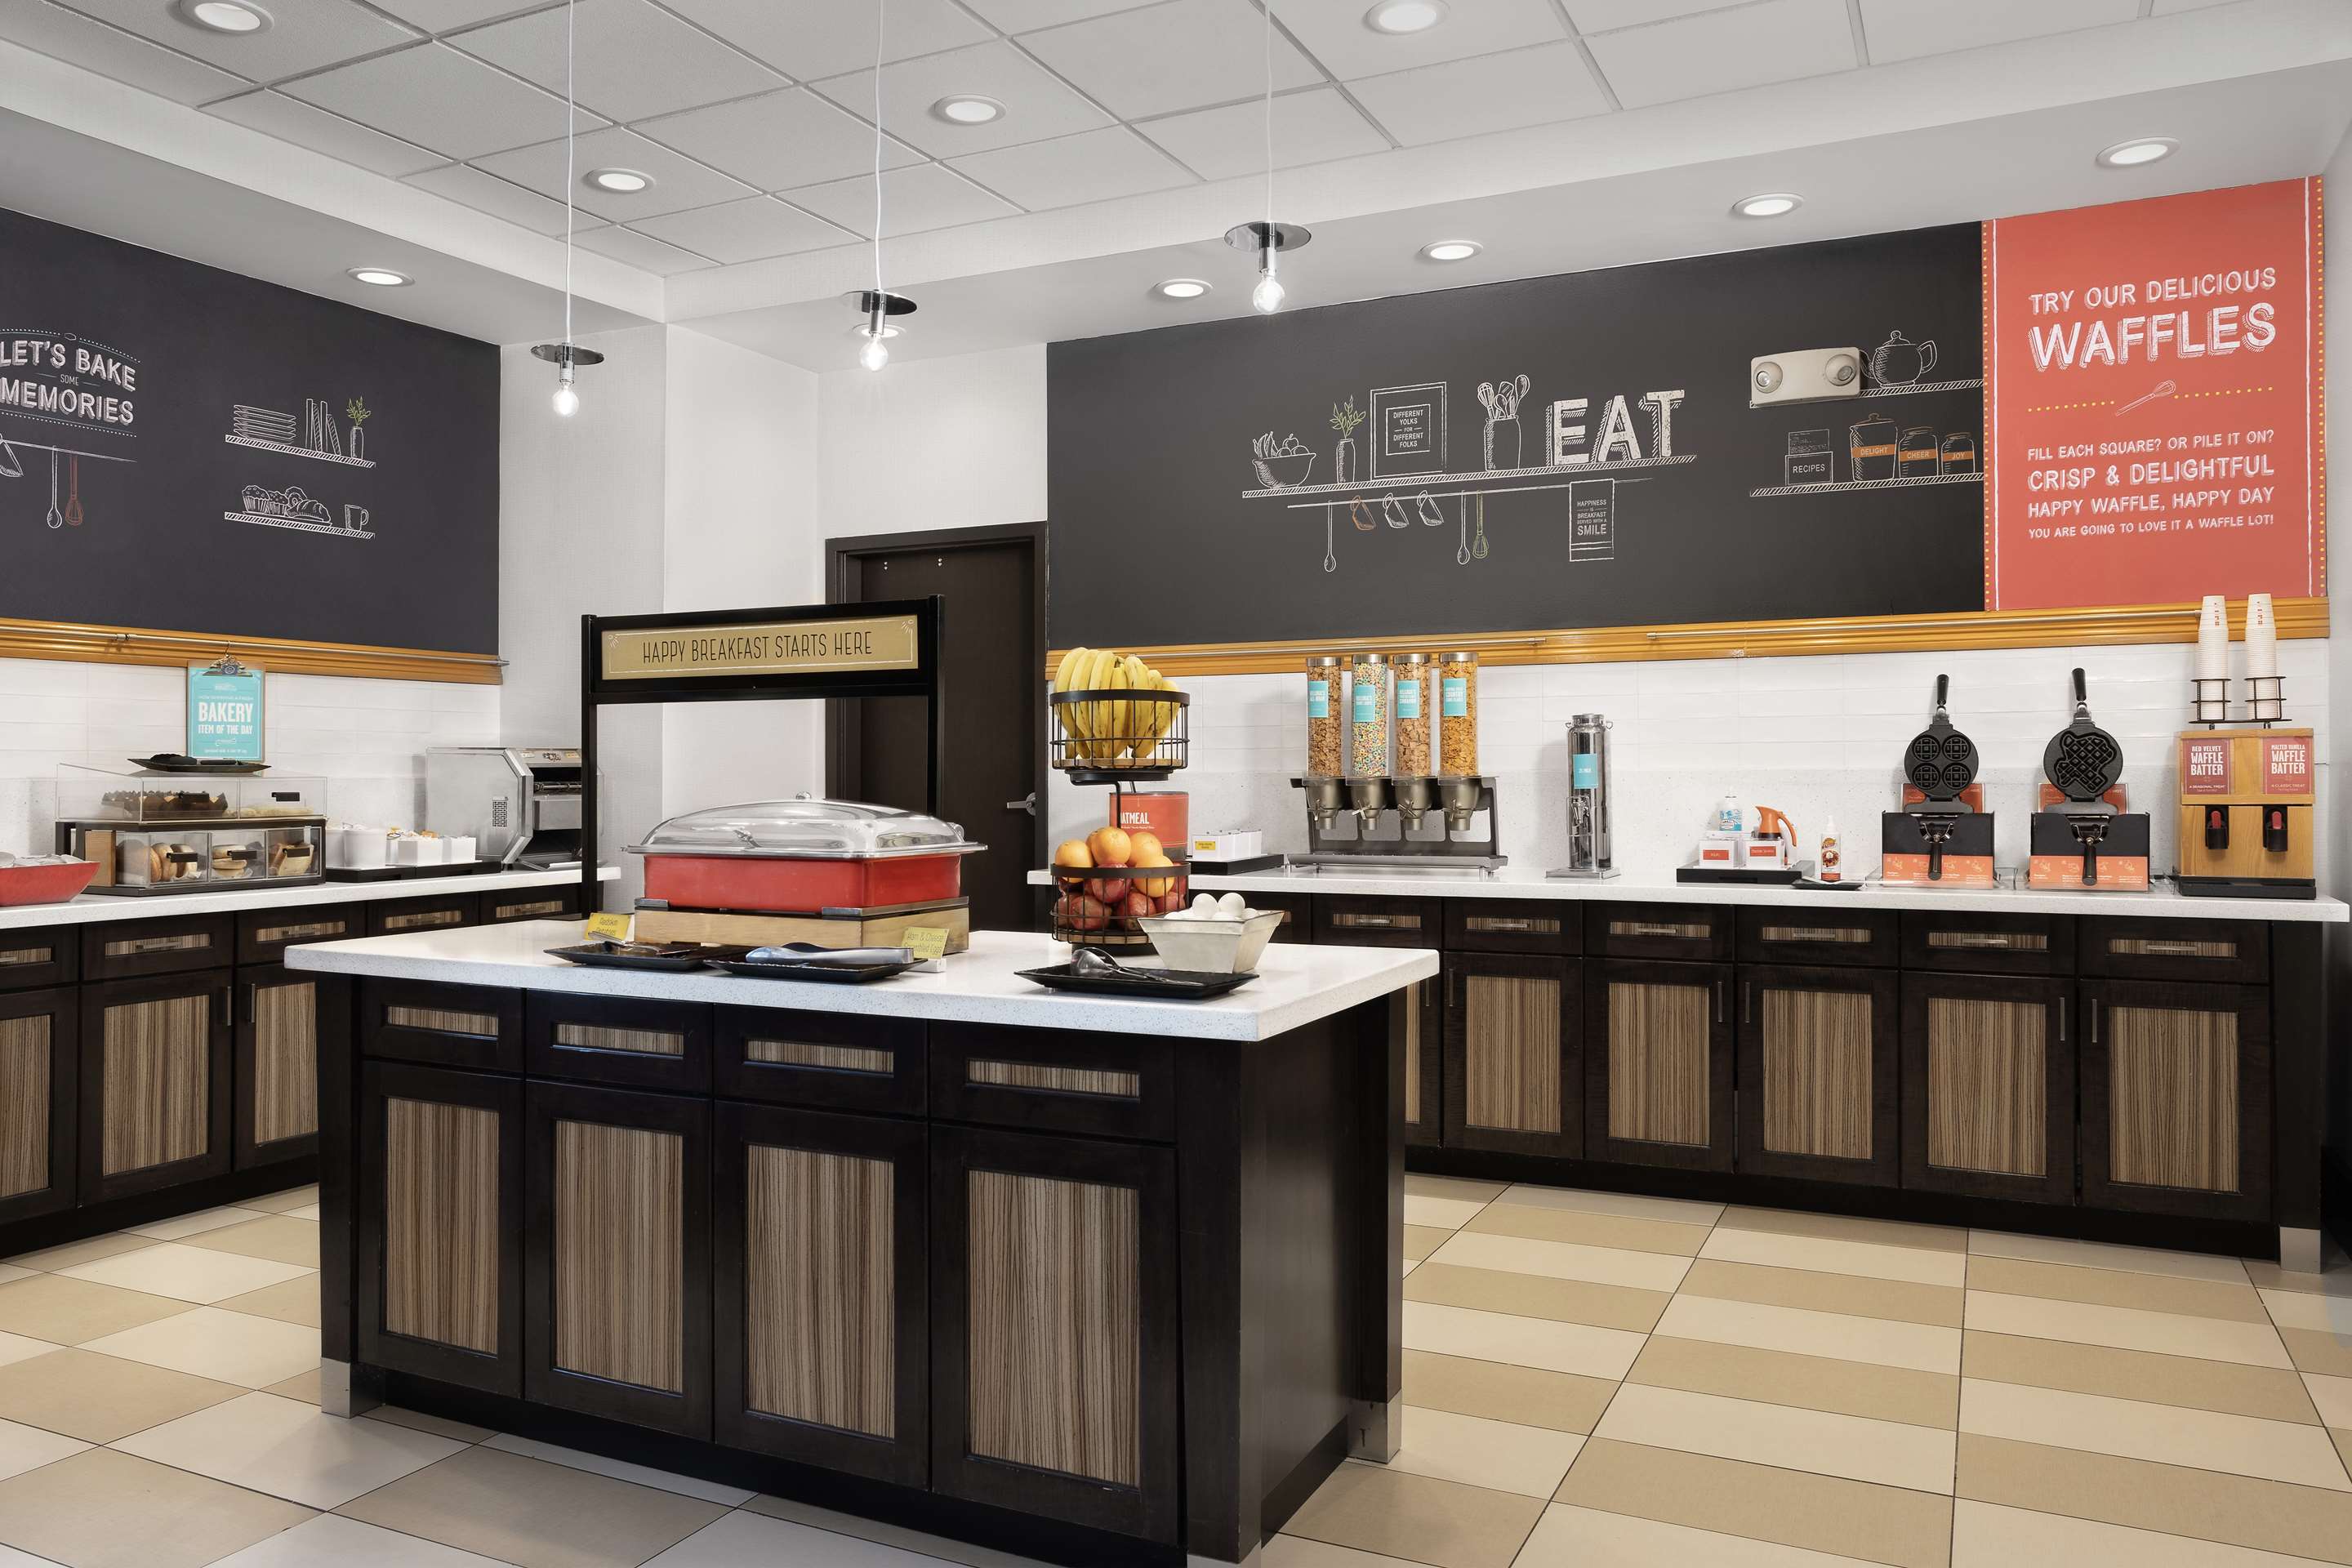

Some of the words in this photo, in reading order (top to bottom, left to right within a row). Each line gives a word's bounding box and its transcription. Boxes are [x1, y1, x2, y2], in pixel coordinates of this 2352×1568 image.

[2029, 291, 2074, 314] TRY
[2084, 284, 2136, 309] OUR
[2146, 267, 2276, 303] DELICIOUS
[2028, 302, 2276, 372] WAFFLES
[0, 340, 66, 368] LET'S
[76, 348, 136, 392] BAKE
[60, 373, 79, 386] SOME
[0, 376, 134, 425] MEMORIES
[1393, 409, 1423, 418] DIFFERENT
[1546, 390, 1685, 466] EAT
[1393, 433, 1423, 441] DIFFERENT
[2028, 448, 2053, 461] FILL
[2058, 444, 2094, 459] EACH
[2099, 439, 2162, 456] SQUARE?
[2167, 437, 2187, 450] OR
[2194, 434, 2222, 448] PILE
[2227, 432, 2240, 446] IT
[2247, 429, 2274, 444] ON?
[1860, 447, 1888, 456] DELIGHT
[1907, 451, 1930, 459] CHEER
[1793, 464, 1825, 474] RECIPES
[2028, 467, 2096, 491] CRISP
[2105, 465, 2119, 486] &
[2130, 454, 2274, 485] DELIGHTFUL
[2028, 499, 2083, 518] HAPPY
[2091, 493, 2165, 514] WAFFLE,
[2172, 489, 2231, 509] HAPPY
[2238, 486, 2274, 505] DAY
[1577, 524, 1607, 536] SMILE
[2029, 528, 2050, 540] YOU
[2054, 526, 2077, 537] ARE
[2081, 523, 2115, 536] GOING
[2119, 523, 2134, 533] TO
[2139, 520, 2167, 532] LOVE
[2171, 519, 2181, 530] IT
[2185, 519, 2194, 529] A
[2198, 516, 2244, 528] WAFFLE
[2248, 514, 2274, 525] LOT!
[644, 640, 686, 663] HAPPY
[692, 636, 769, 662] BREAKFAST
[775, 634, 826, 658] STARTS
[835, 631, 872, 656] HERE
[198, 702, 253, 723] BAKERY
[198, 724, 214, 734] ITEM
[216, 724, 224, 734] OF
[226, 724, 238, 735] THE
[241, 724, 252, 735] DAY
[2191, 752, 2223, 764] WAFFLE
[2271, 751, 2305, 762] WAFFLE
[2191, 764, 2223, 776] BATTER
[2271, 762, 2305, 774] BATTER
[1120, 812, 1149, 824] ATMEAL
